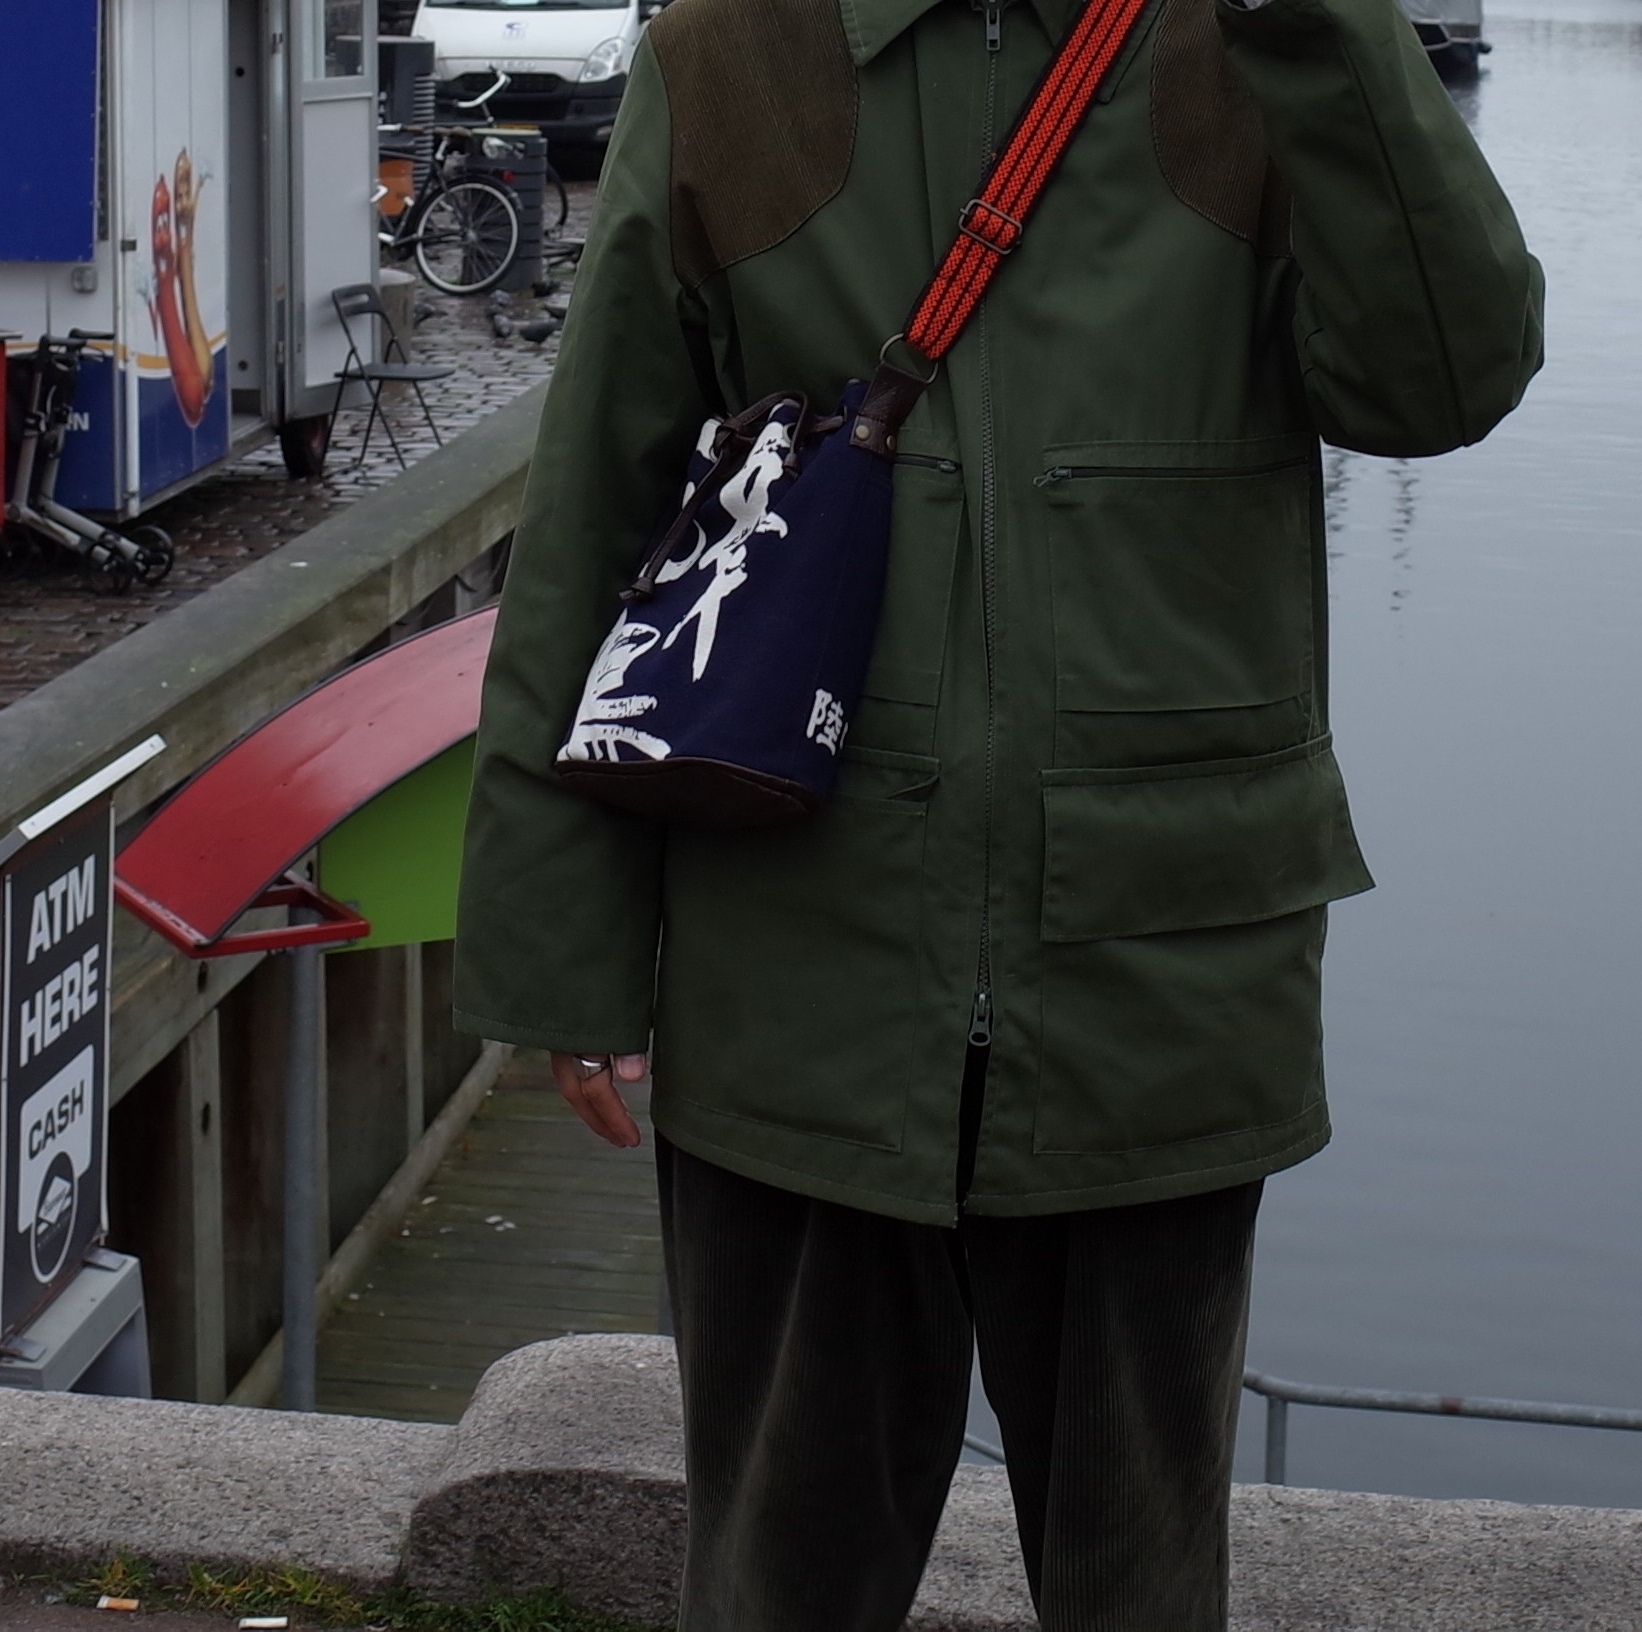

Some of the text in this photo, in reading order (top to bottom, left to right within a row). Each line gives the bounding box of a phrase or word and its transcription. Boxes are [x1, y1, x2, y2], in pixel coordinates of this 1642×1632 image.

[27, 854, 96, 965] ATM
[20, 943, 100, 1068] HERE
[28, 1079, 85, 1161] CASH
